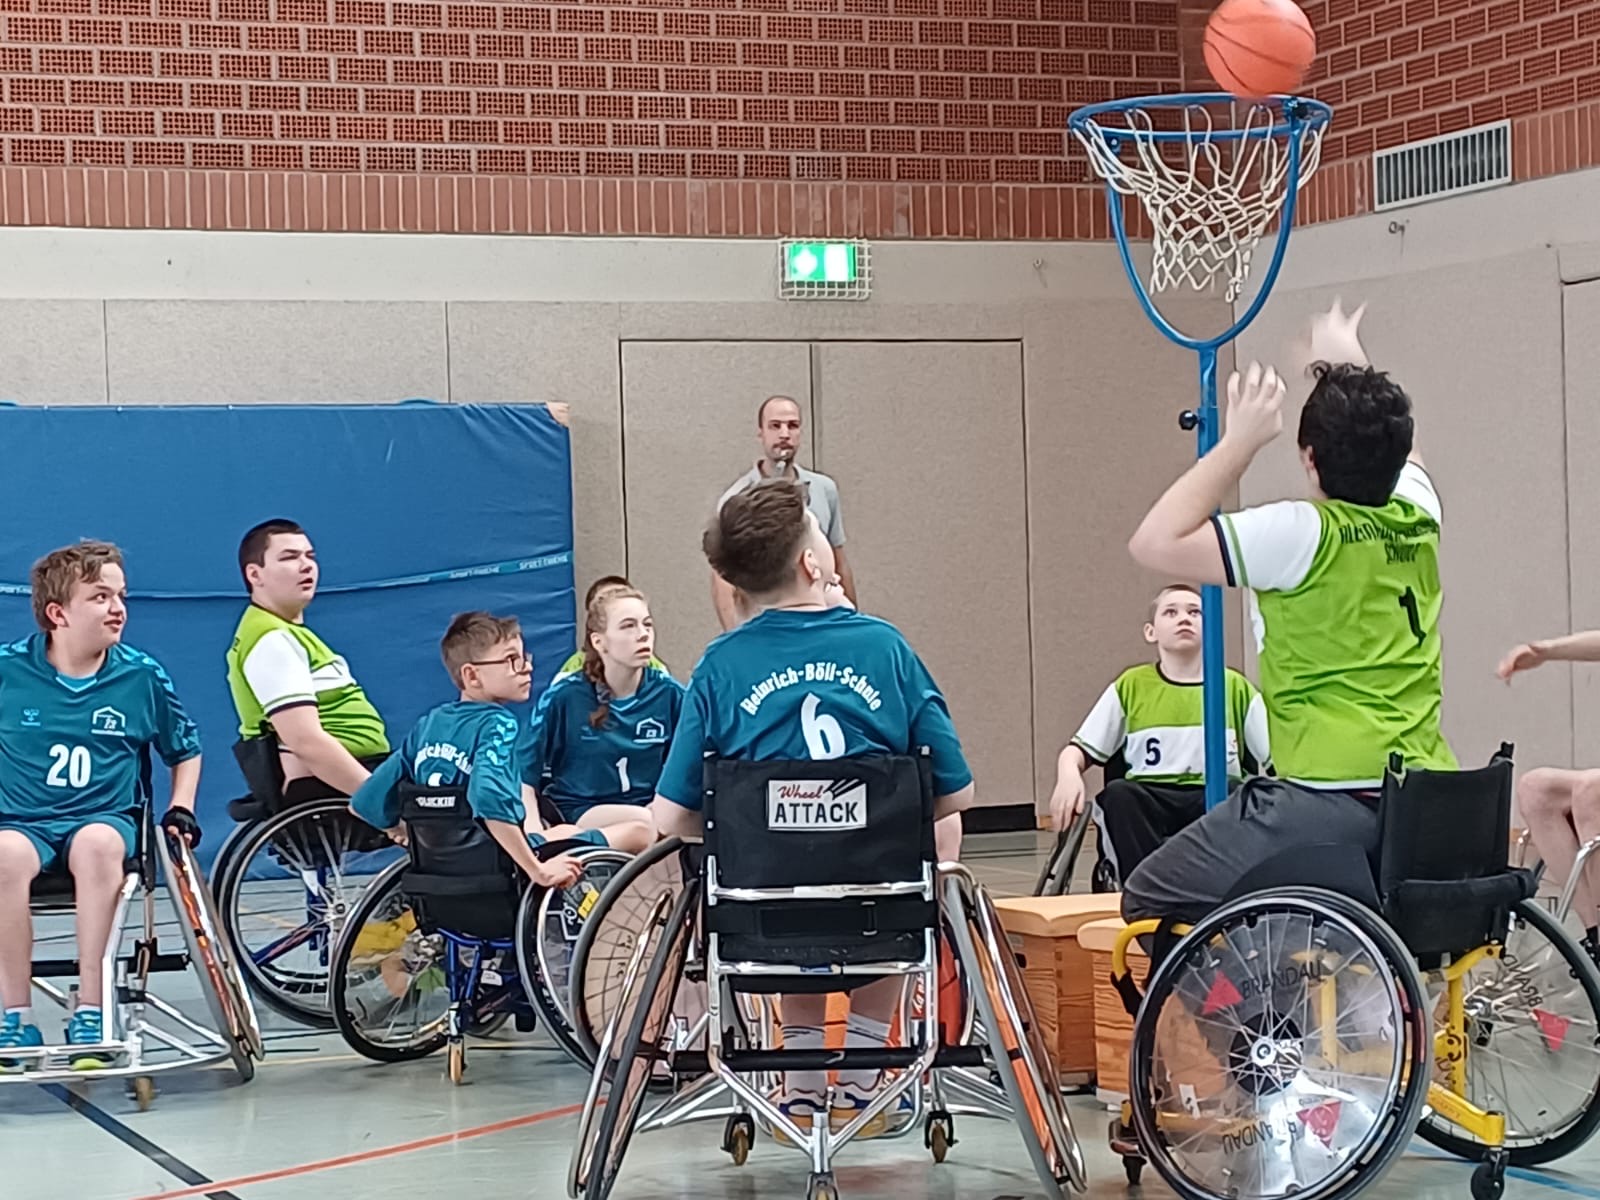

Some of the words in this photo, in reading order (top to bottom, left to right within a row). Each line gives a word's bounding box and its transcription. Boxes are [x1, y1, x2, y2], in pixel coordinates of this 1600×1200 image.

[1398, 585, 1427, 644] 1
[740, 662, 882, 716] Heinrich-Böll-Schule
[801, 692, 846, 760] 6
[46, 743, 91, 788] 20
[1145, 737, 1161, 766] 5
[616, 757, 630, 793] 1
[777, 784, 824, 800] Wheel
[774, 802, 858, 823] ATTACK
